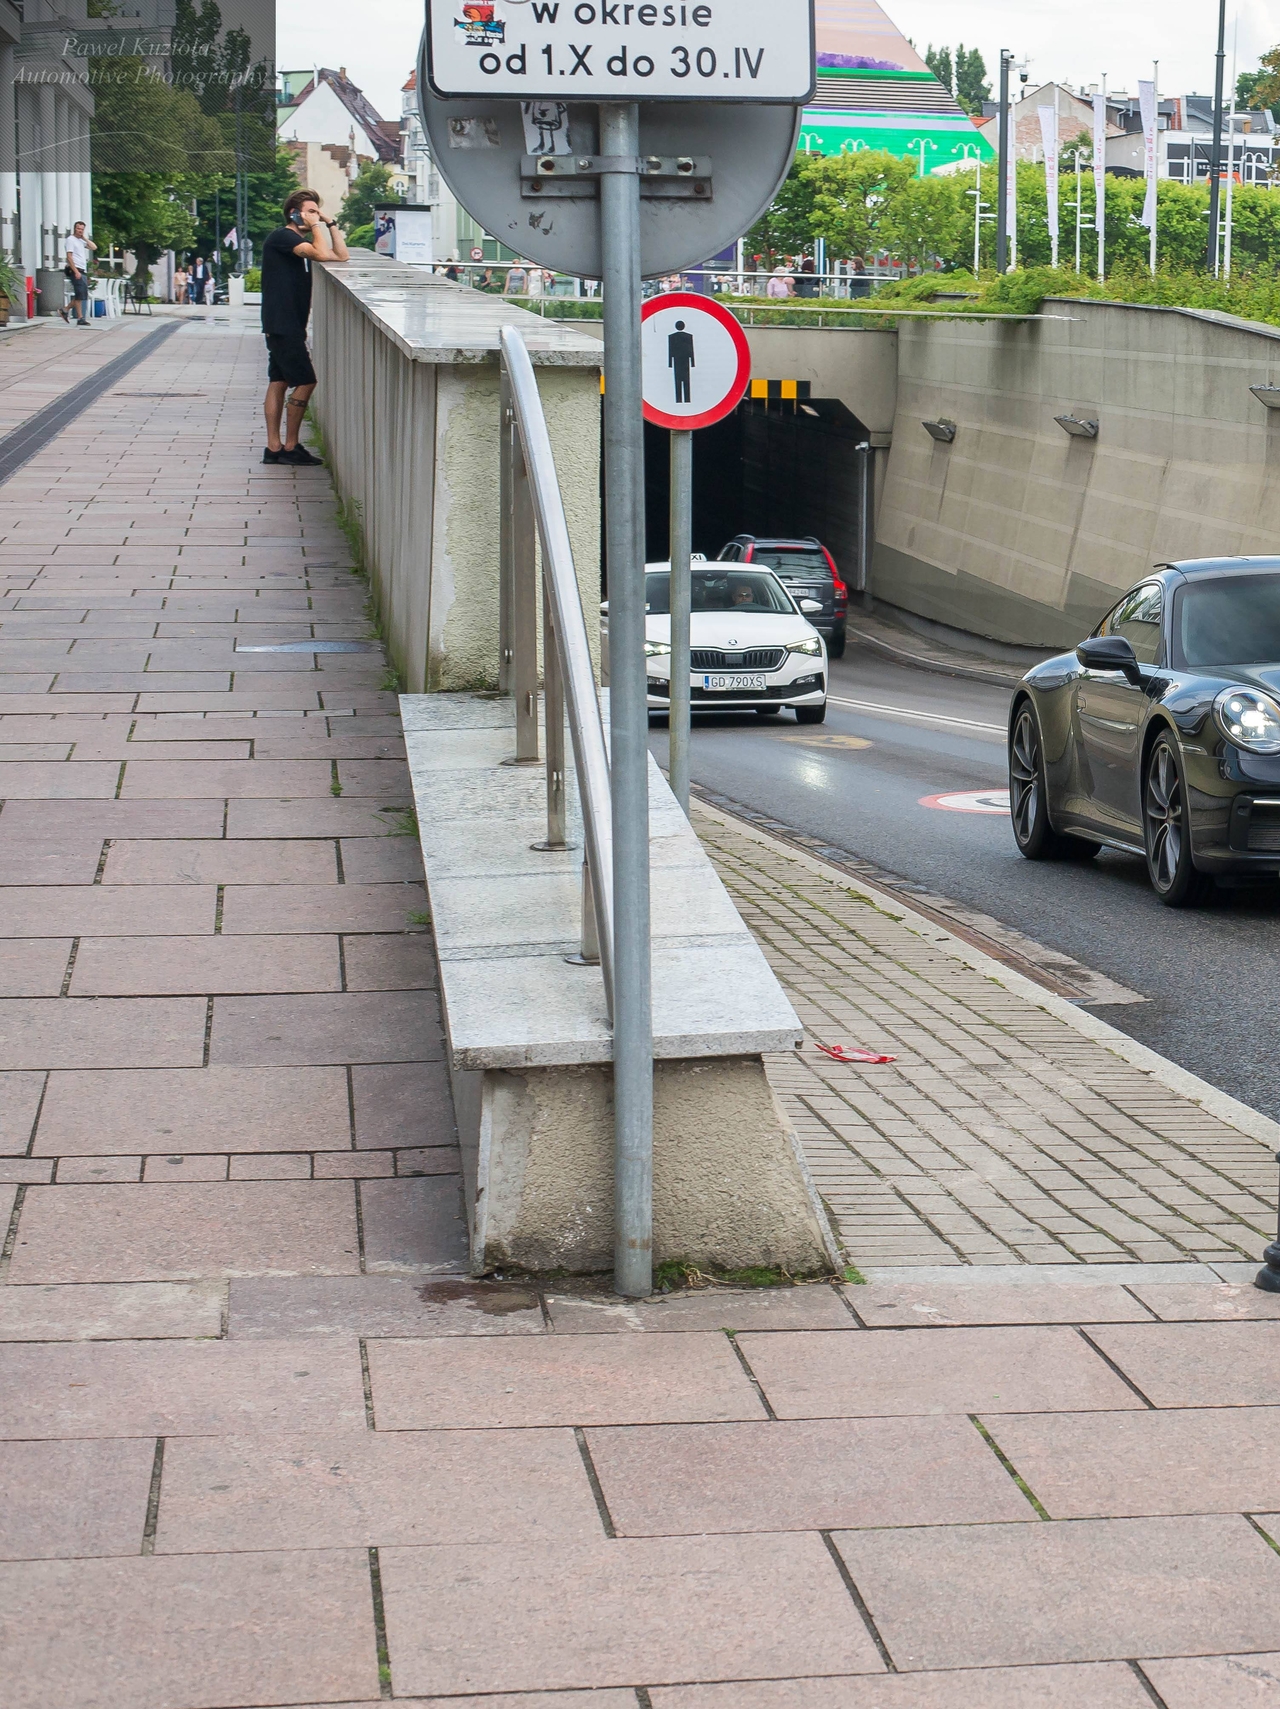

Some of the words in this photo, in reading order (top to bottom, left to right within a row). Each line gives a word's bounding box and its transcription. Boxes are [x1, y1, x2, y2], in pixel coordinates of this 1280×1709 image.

[532, 2, 560, 23] w
[573, 0, 713, 27] okresie
[479, 43, 527, 75] od
[541, 43, 594, 76] 1.X
[606, 45, 655, 77] do
[670, 46, 765, 79] 30.IV
[711, 676, 726, 688] GD
[729, 676, 763, 687] 790XS
